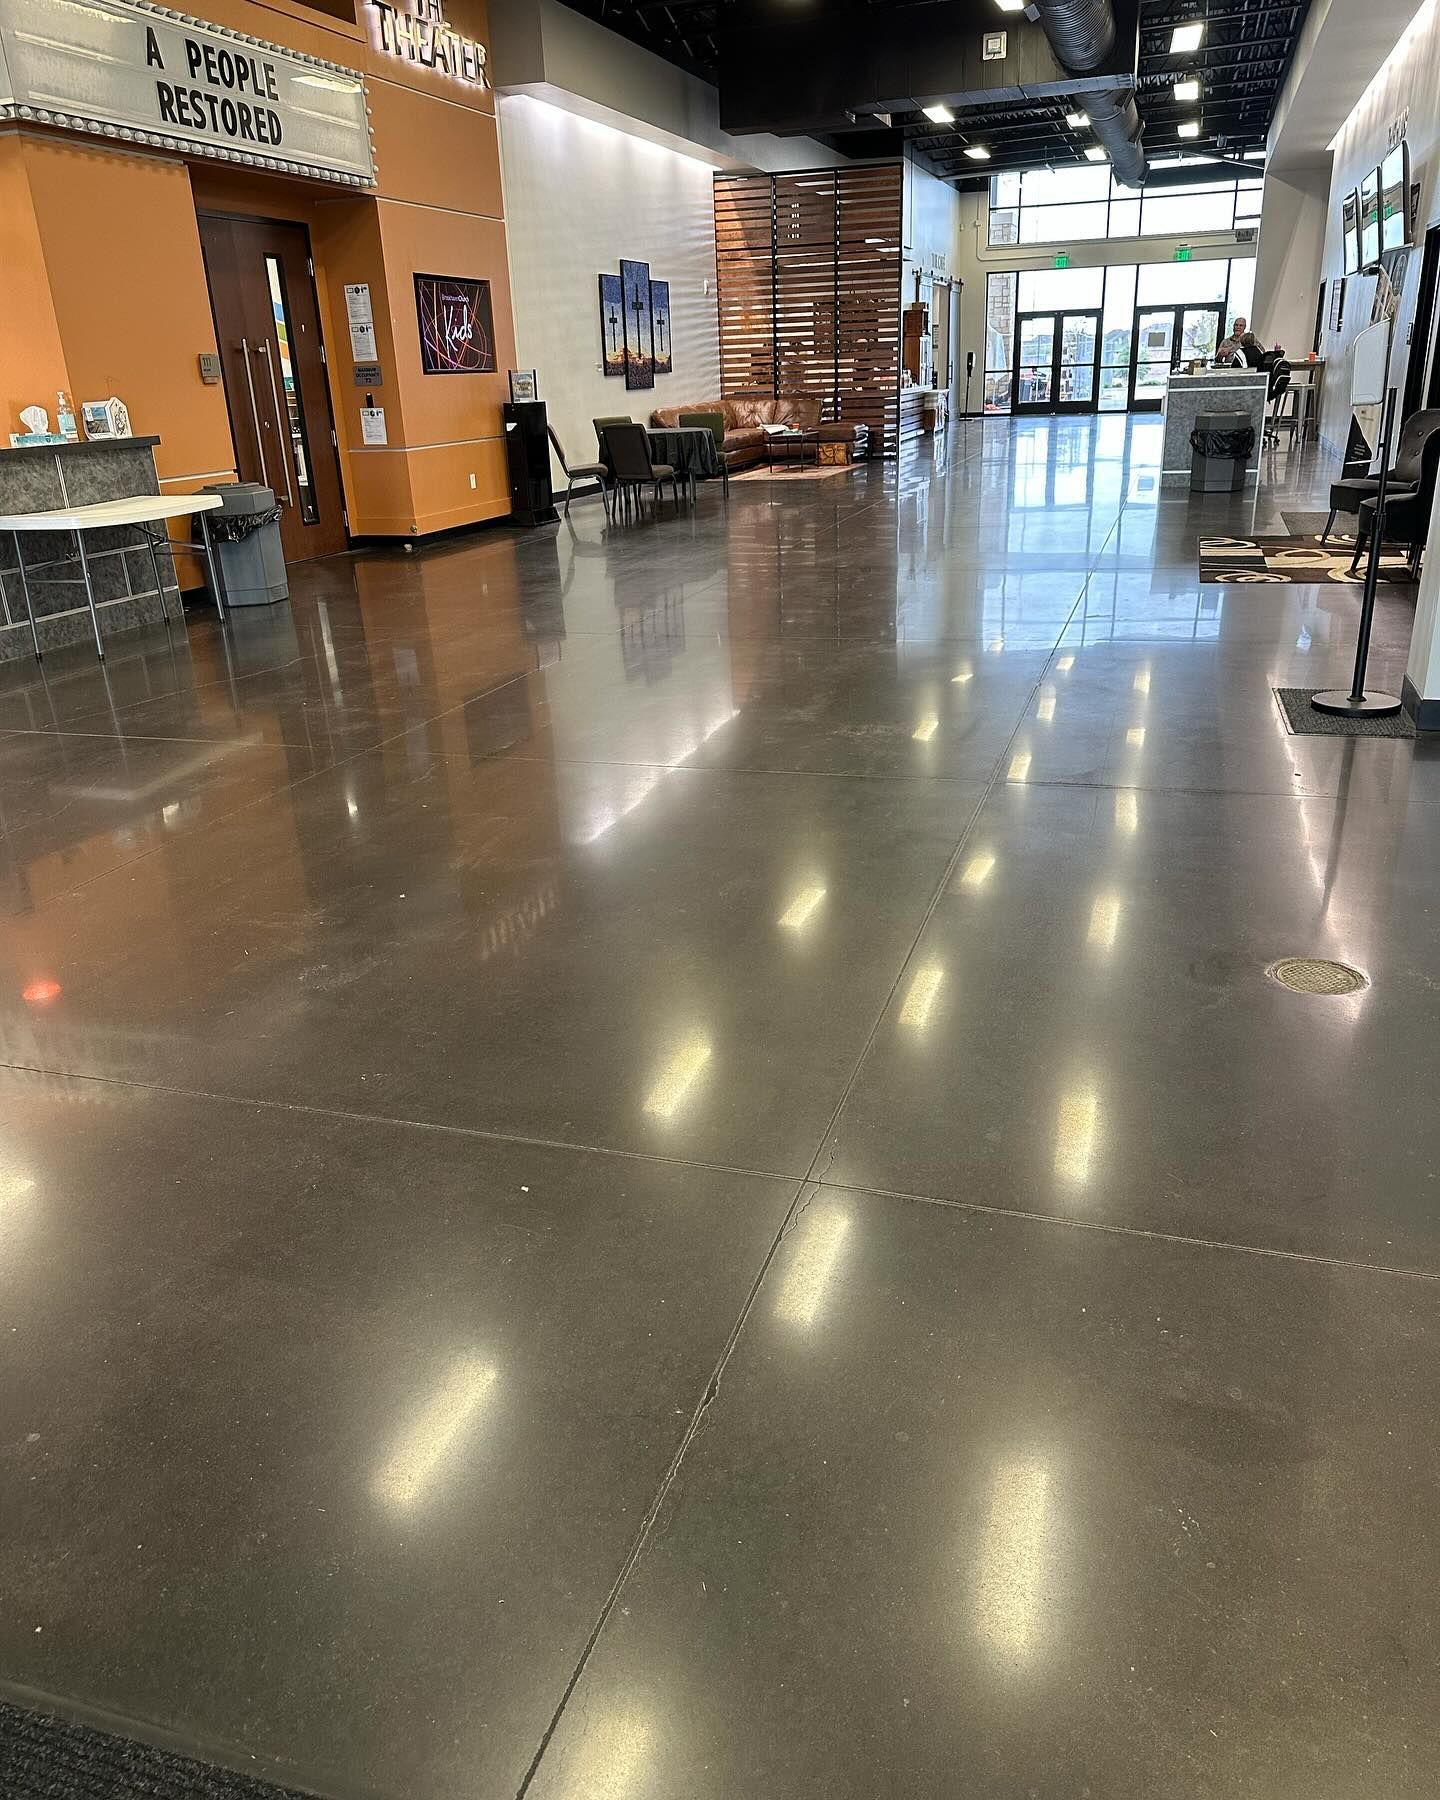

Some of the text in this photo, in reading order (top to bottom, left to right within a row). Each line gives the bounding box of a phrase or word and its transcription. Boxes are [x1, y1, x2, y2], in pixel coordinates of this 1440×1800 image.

[146, 26, 279, 101] A PEOPLE
[372, 0, 491, 89] THEATER
[156, 81, 282, 146] RESTORED
[443, 303, 473, 357] Kids
